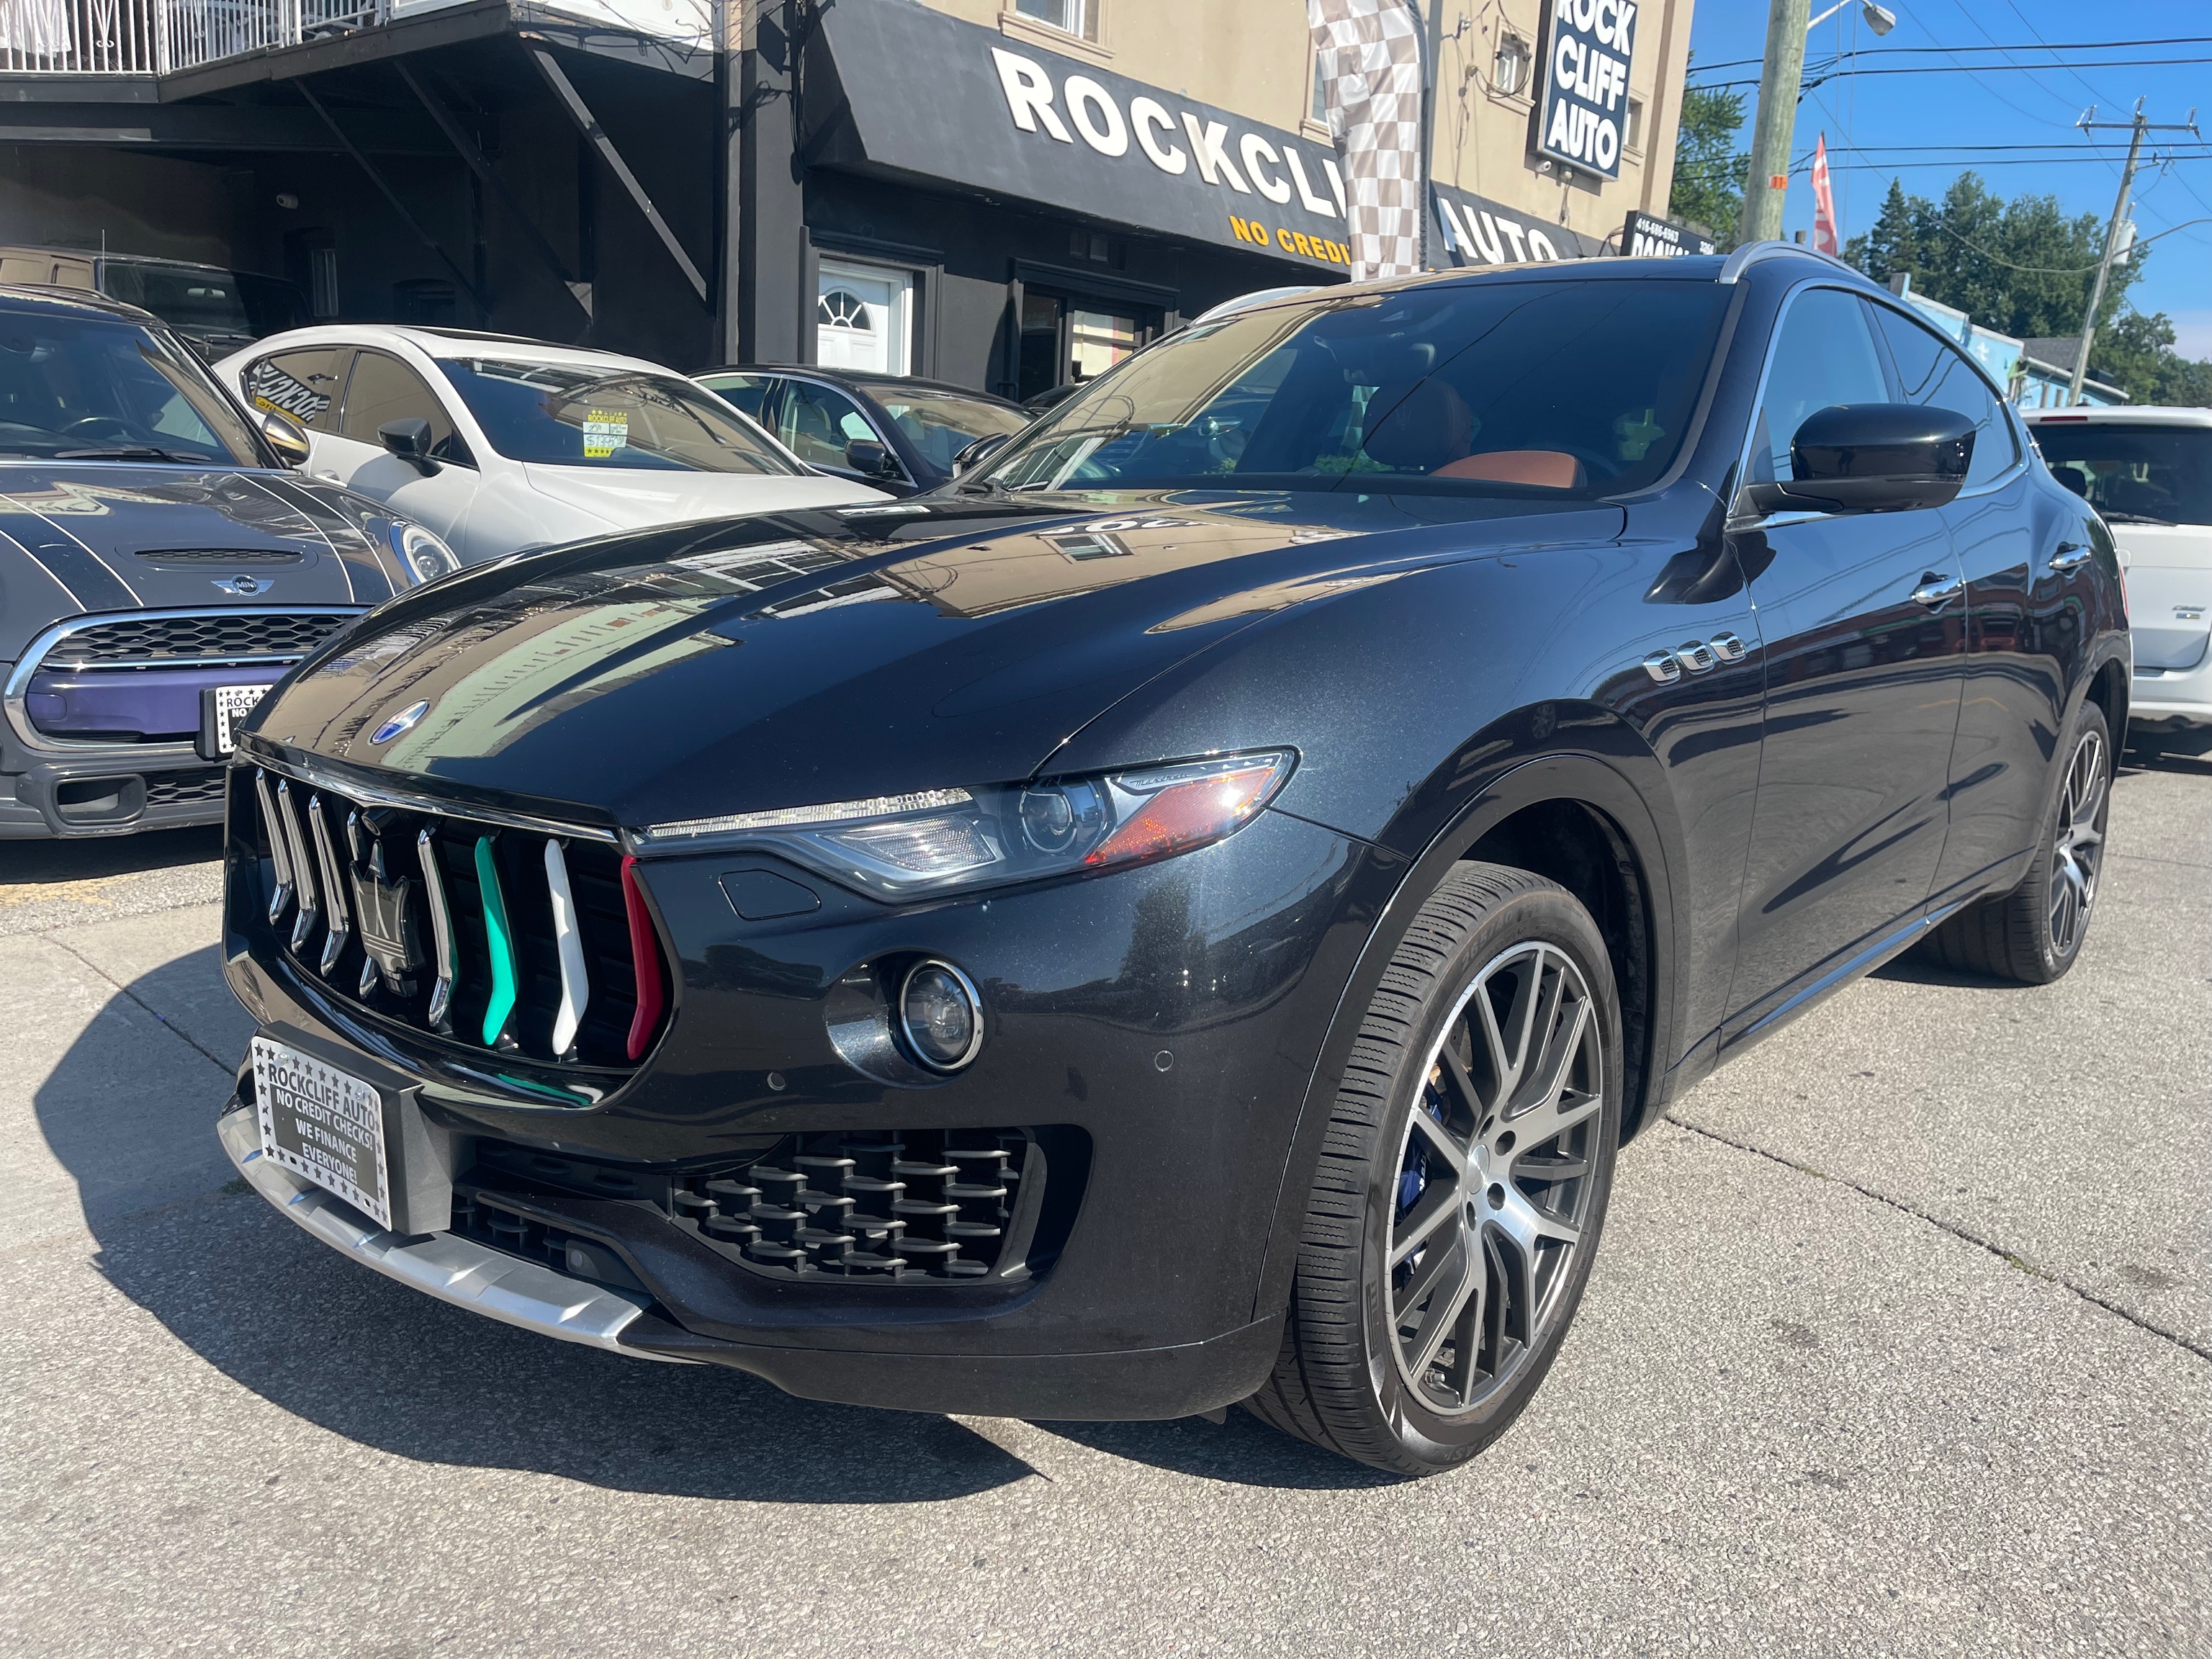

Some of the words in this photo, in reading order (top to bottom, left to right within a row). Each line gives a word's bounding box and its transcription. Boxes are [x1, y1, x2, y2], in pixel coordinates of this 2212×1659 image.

[1555, 34, 1627, 111] CLIFF
[1547, 98, 1619, 170] AUTO
[1229, 215, 1269, 246] NO
[1277, 228, 1352, 266] CREDI
[588, 414, 615, 423] ROCKCLIFF
[232, 708, 248, 717] NO
[1130, 772, 1193, 787] Maserati
[268, 1062, 341, 1112] ROCKCLIFF
[343, 1096, 376, 1131] AUTO
[276, 1088, 294, 1109] NO
[295, 1097, 332, 1128] CREDIT
[333, 1114, 374, 1151] CHECKS!
[295, 1118, 314, 1138] WE
[314, 1128, 357, 1164] FINANCE
[302, 1141, 358, 1184] EVERYONE!
